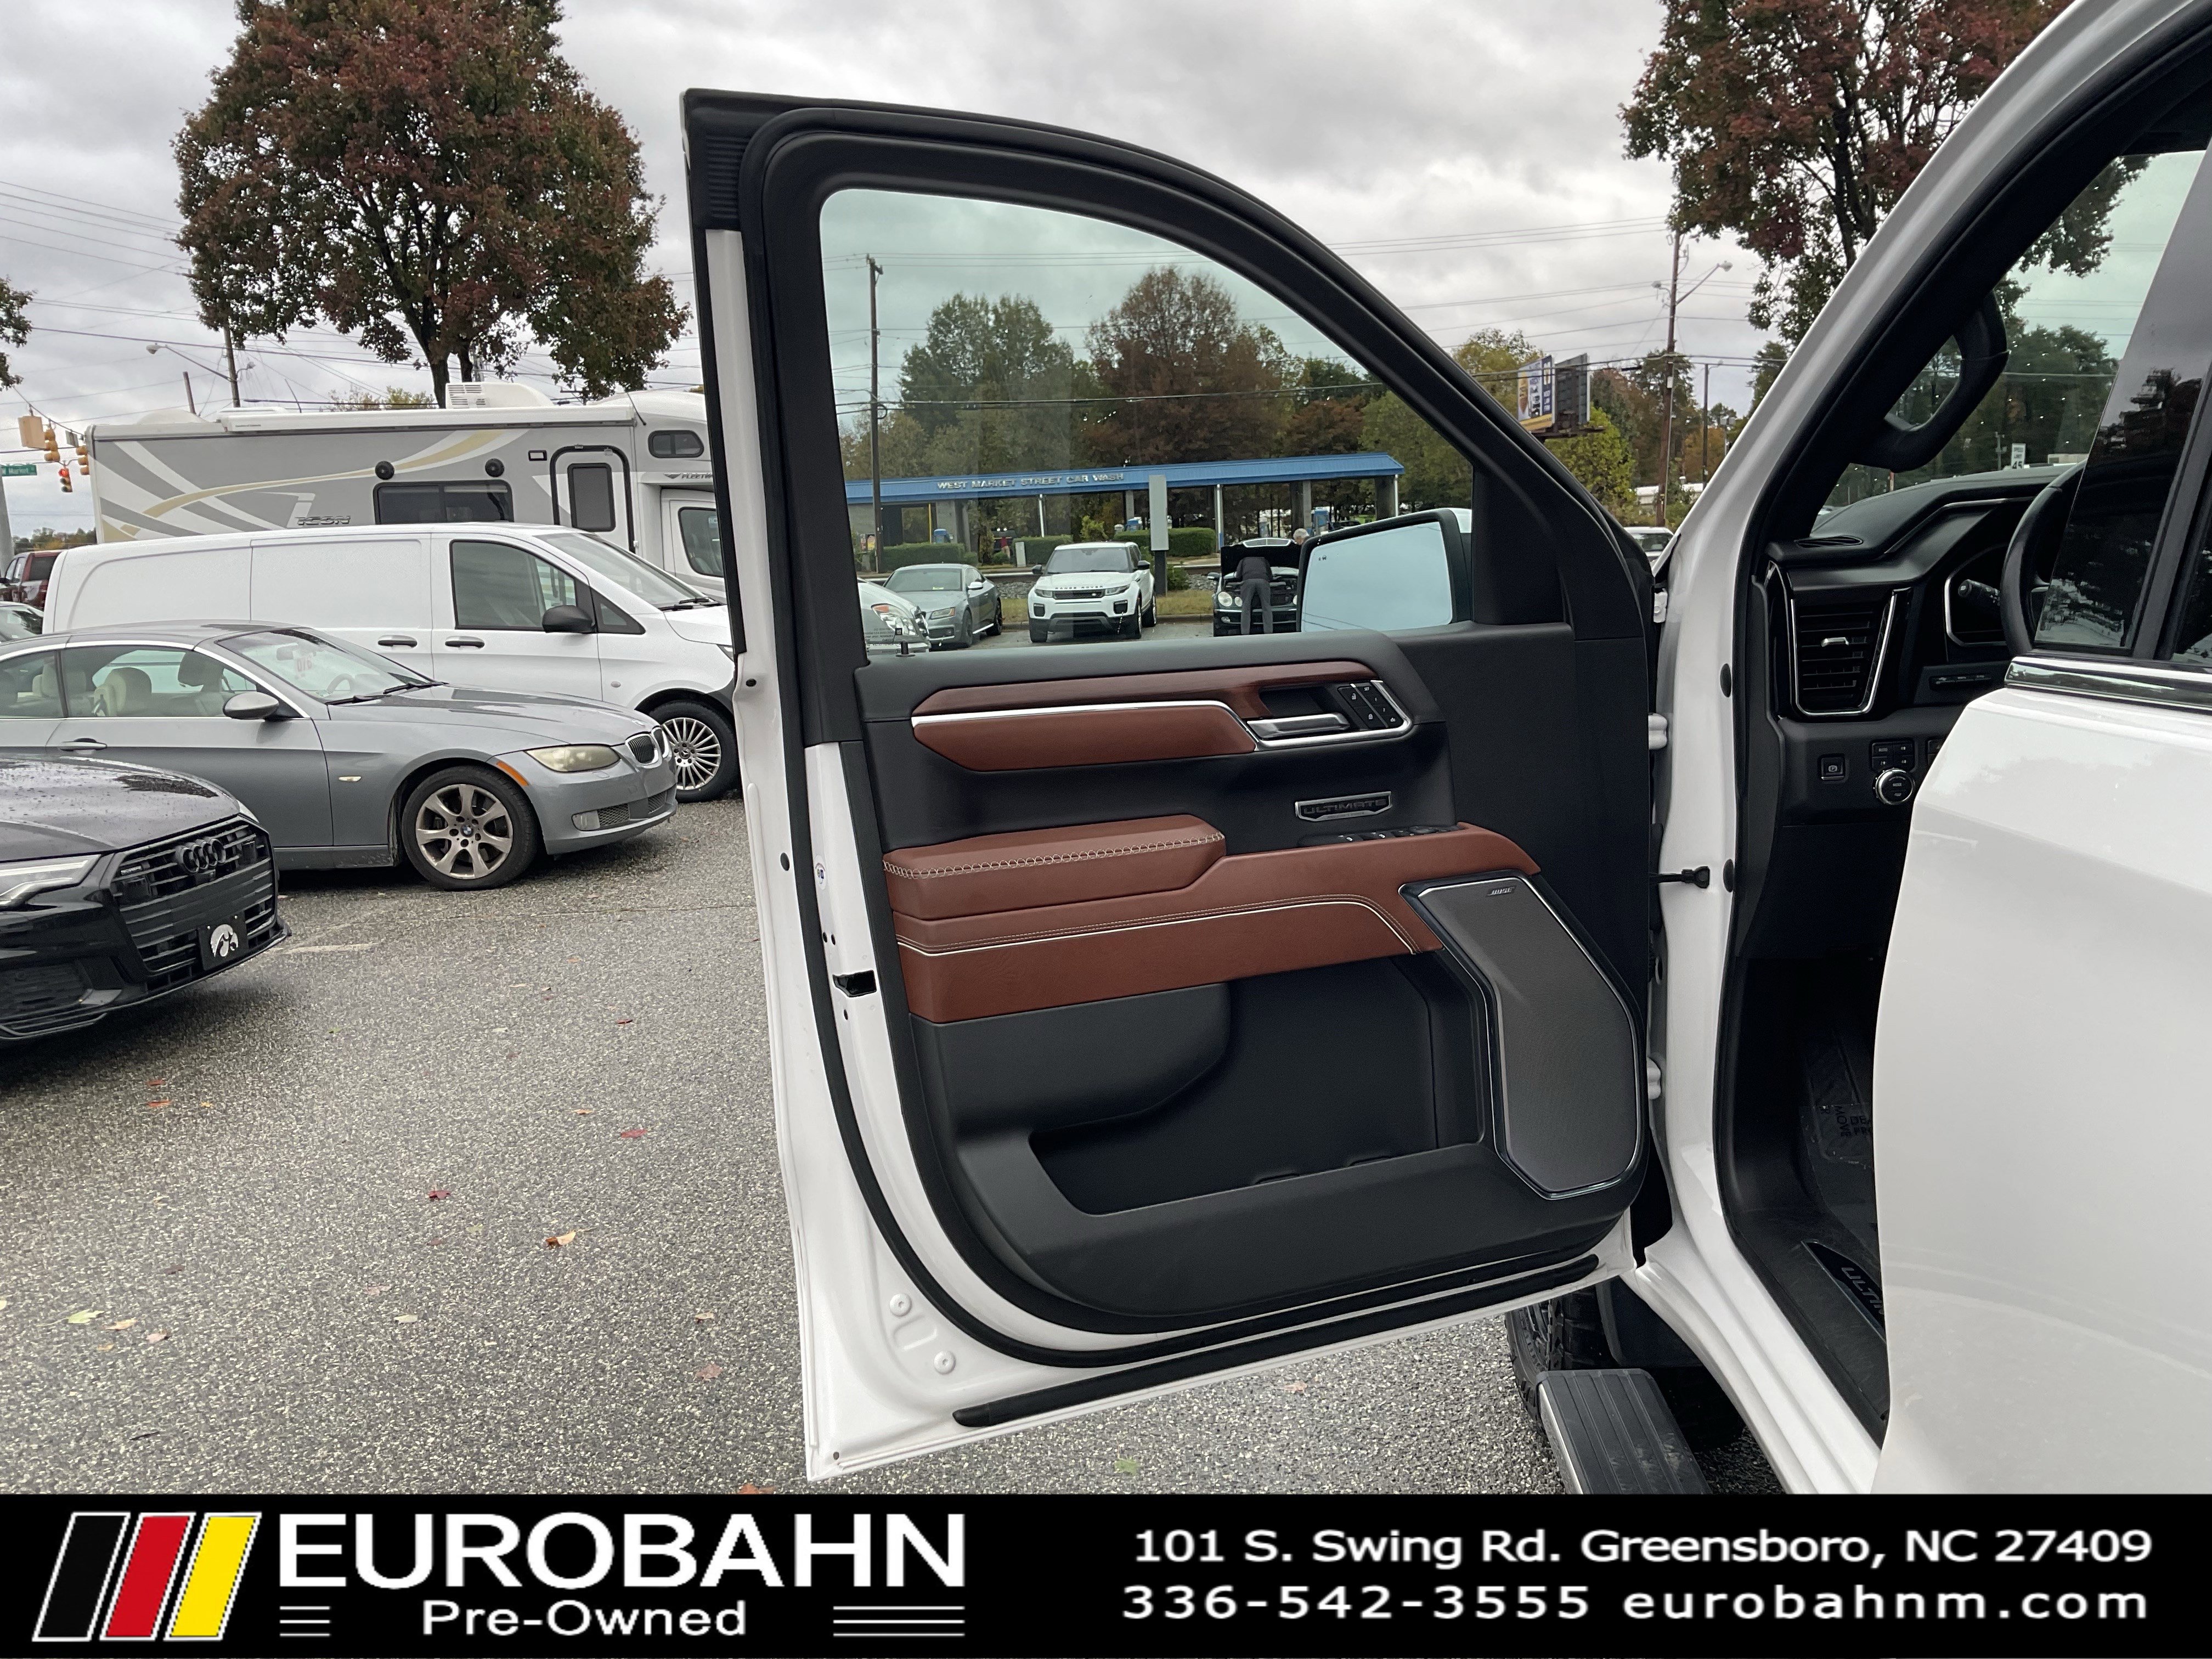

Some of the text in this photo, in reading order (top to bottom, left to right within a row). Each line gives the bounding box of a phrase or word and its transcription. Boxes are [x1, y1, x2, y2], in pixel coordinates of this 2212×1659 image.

[937, 473, 1124, 489] WEST MARKET STREET CAR WASH
[1304, 799, 1387, 815] ULTIMATE
